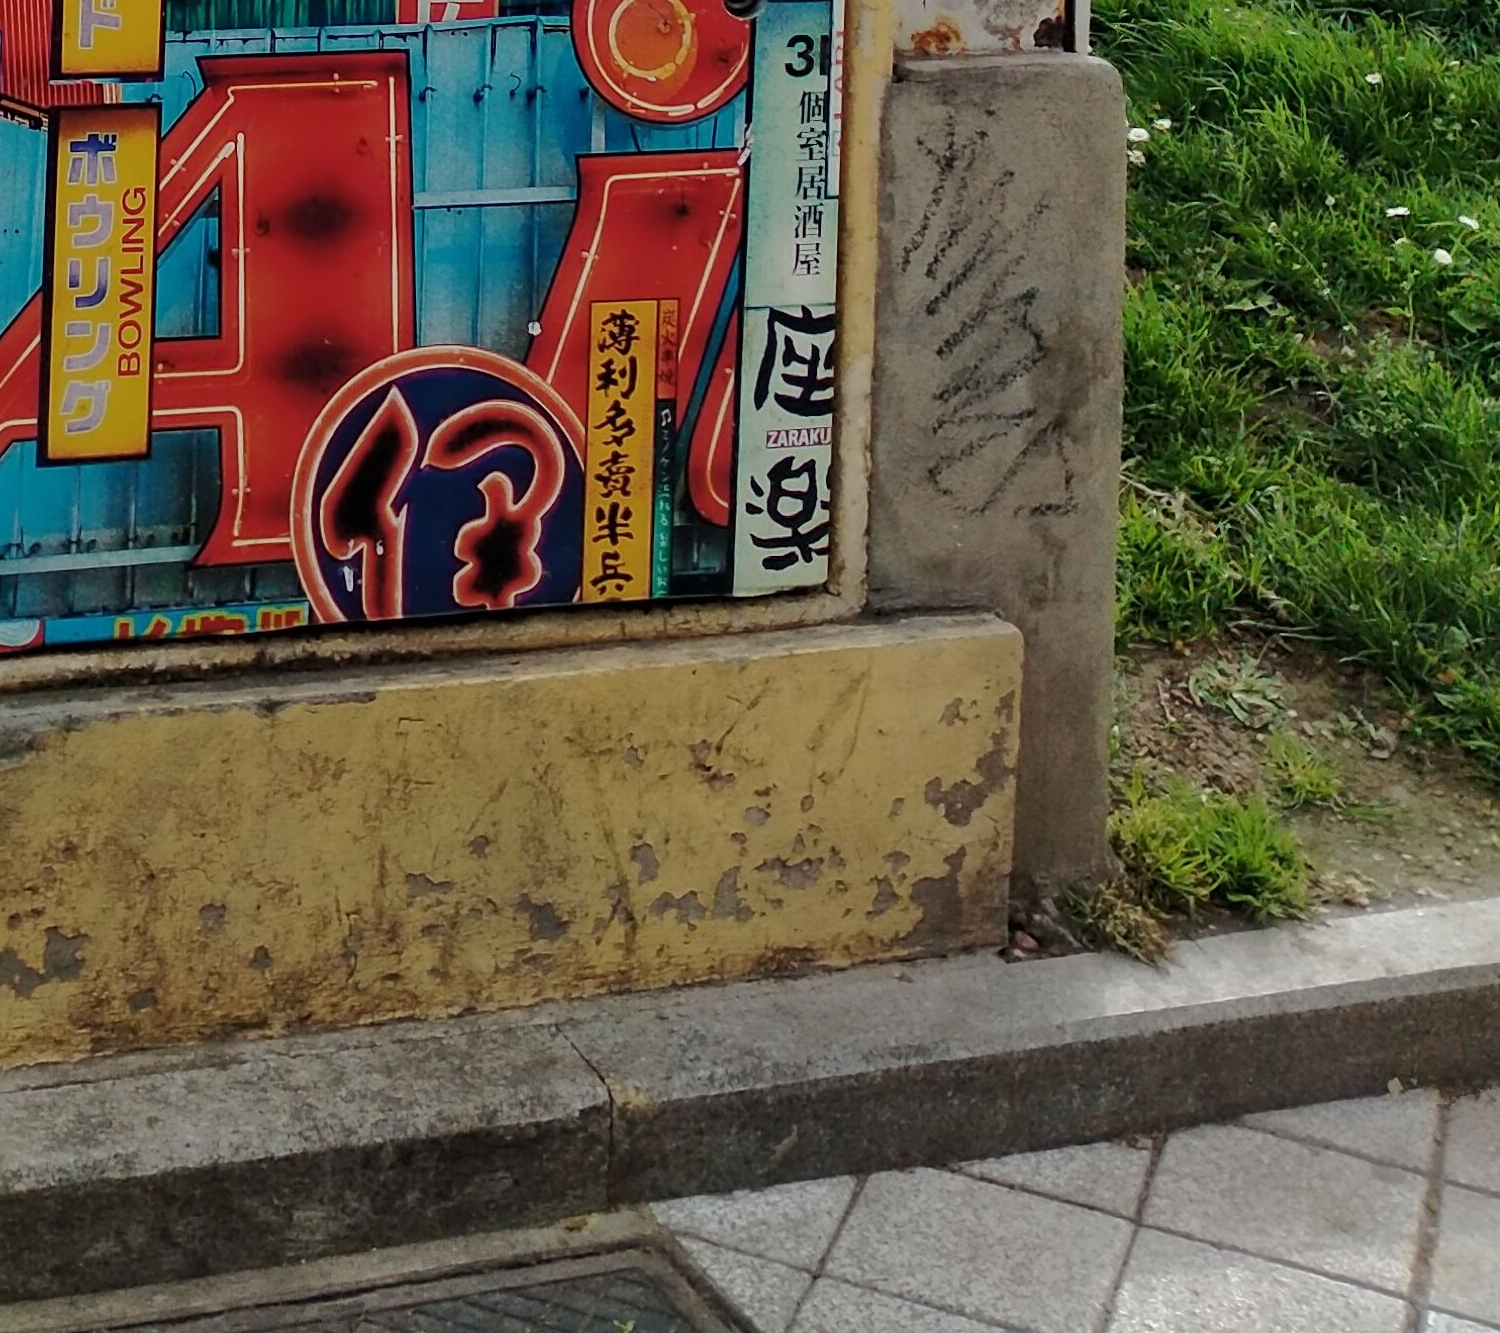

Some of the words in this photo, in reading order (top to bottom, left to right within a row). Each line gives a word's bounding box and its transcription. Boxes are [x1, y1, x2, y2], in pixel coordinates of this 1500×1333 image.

[791, 89, 826, 277] 個室居酒屋
[59, 132, 118, 435] ボウリング
[117, 186, 147, 378] BOWLING
[767, 426, 832, 448] ZARAKU
